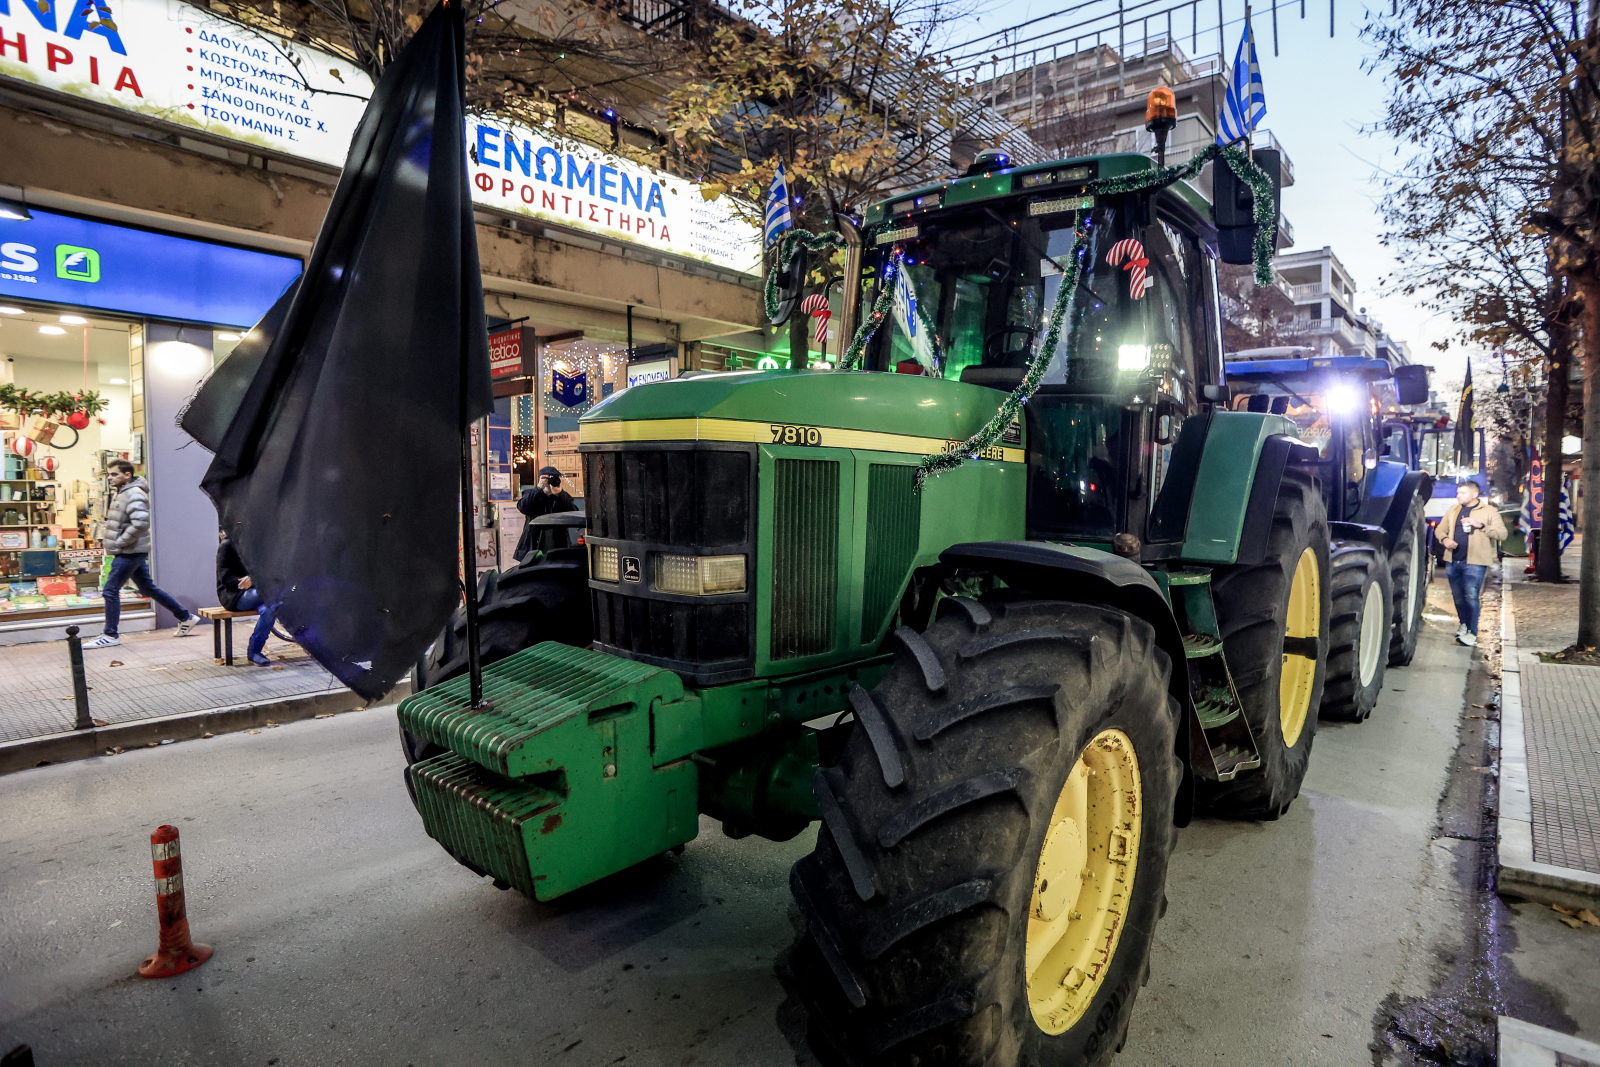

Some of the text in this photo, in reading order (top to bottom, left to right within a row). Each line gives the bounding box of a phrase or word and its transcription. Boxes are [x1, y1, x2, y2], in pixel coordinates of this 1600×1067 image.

[199, 30, 269, 63] ΔΑΟΥΛΑΣ
[200, 48, 286, 85] ΚΩΣΤΟΥΛΑΣ
[200, 67, 297, 107] ΜΠΟΣΙΝΑΚΗΣ
[201, 86, 328, 133] ΞΑΝΘΟΠΟΥΛΟΣ Χ.
[201, 105, 283, 137] ΤΣΟΥΜΑΝΗ
[476, 124, 666, 217] ΕΝΩΜΕΝΑ
[475, 172, 671, 242] ΦΡΟΝΤΙΣΤΗΡΙΑ
[13, 273, 37, 284] 1986
[771, 425, 821, 446] 7810
